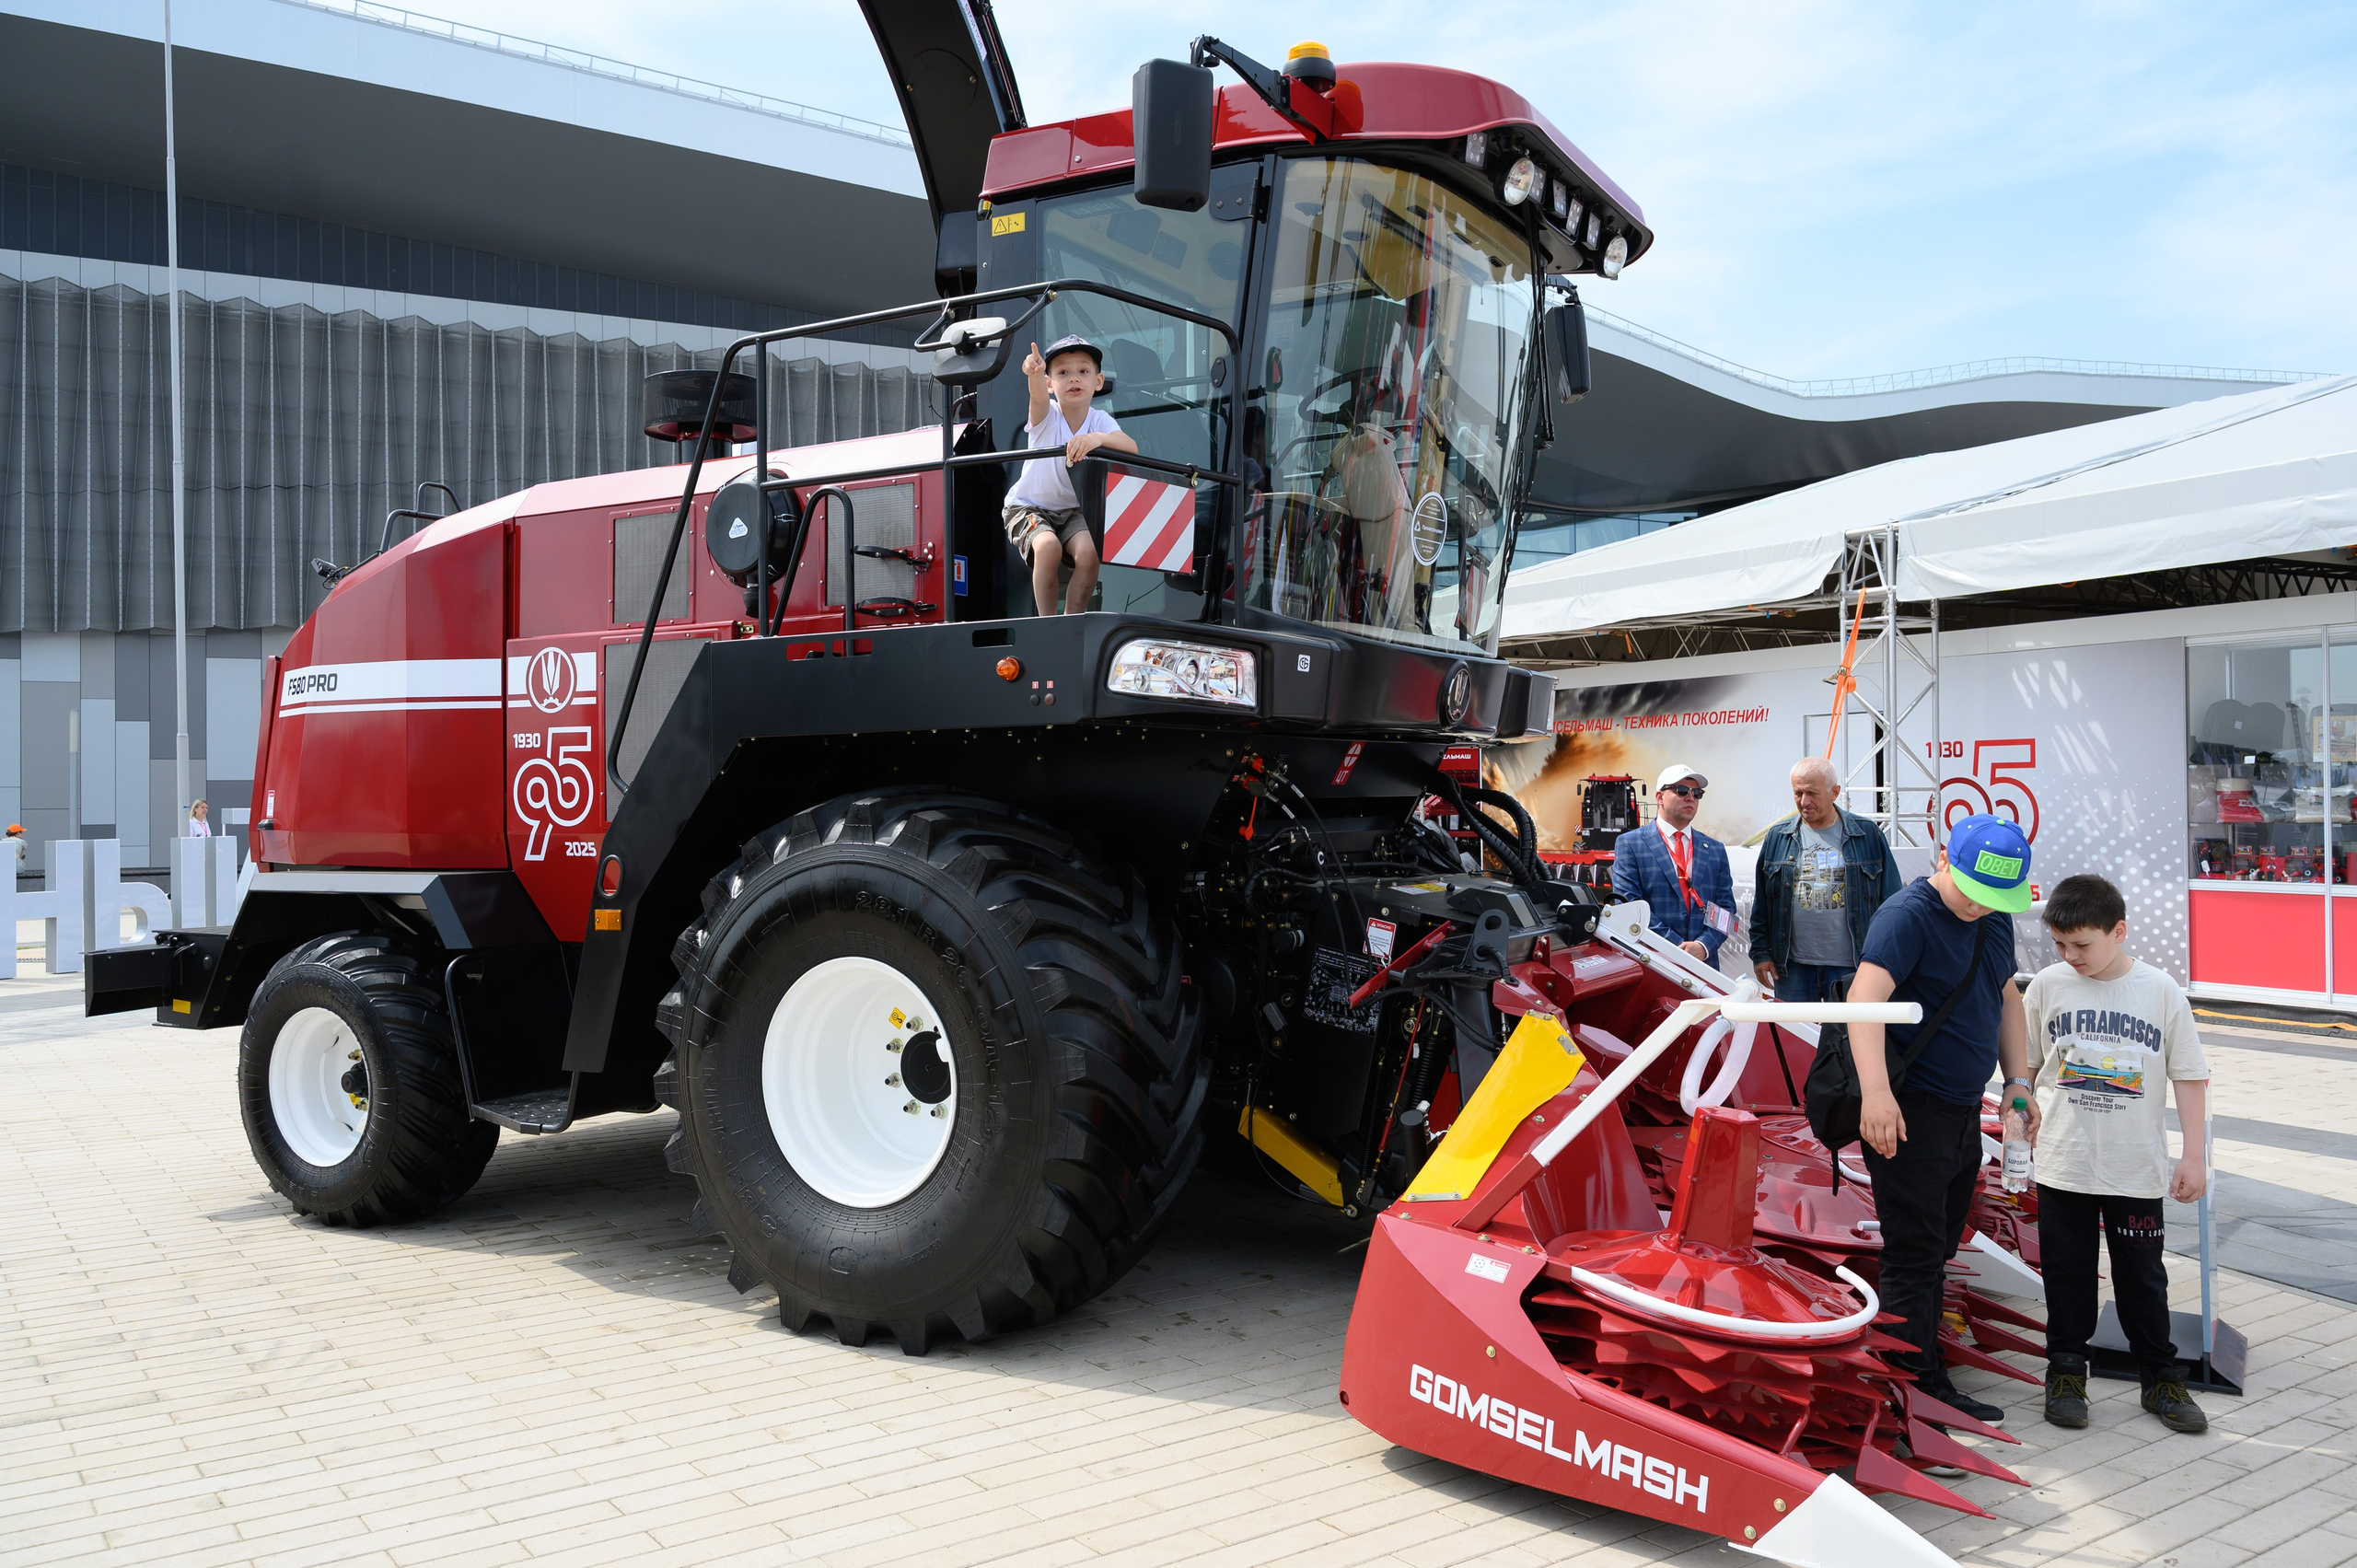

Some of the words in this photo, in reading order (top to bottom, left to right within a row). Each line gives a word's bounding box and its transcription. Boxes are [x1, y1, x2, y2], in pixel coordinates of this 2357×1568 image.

[307, 673, 338, 693] PRO
[1550, 717, 1613, 733] СЕЛЬМАШ
[1624, 713, 1678, 730] ТЕХНИКА
[1682, 704, 1770, 727] ПОКОЛЕНИЙ!
[513, 733, 540, 749] 1930
[1925, 740, 1963, 758] 130
[513, 726, 594, 861] 95
[564, 842, 597, 857] 2025
[1980, 855, 2018, 877] OBEY
[2048, 1011, 2072, 1044] SAN
[2076, 1009, 2162, 1052] FRANCISCO
[2081, 1033, 2121, 1044] CALIFORNIA
[2081, 1094, 2101, 1102] Discover
[2090, 1101, 2114, 1109] Francisco
[2129, 1215, 2156, 1229] BACK
[1409, 1363, 1710, 1515] GOMSELMASH
